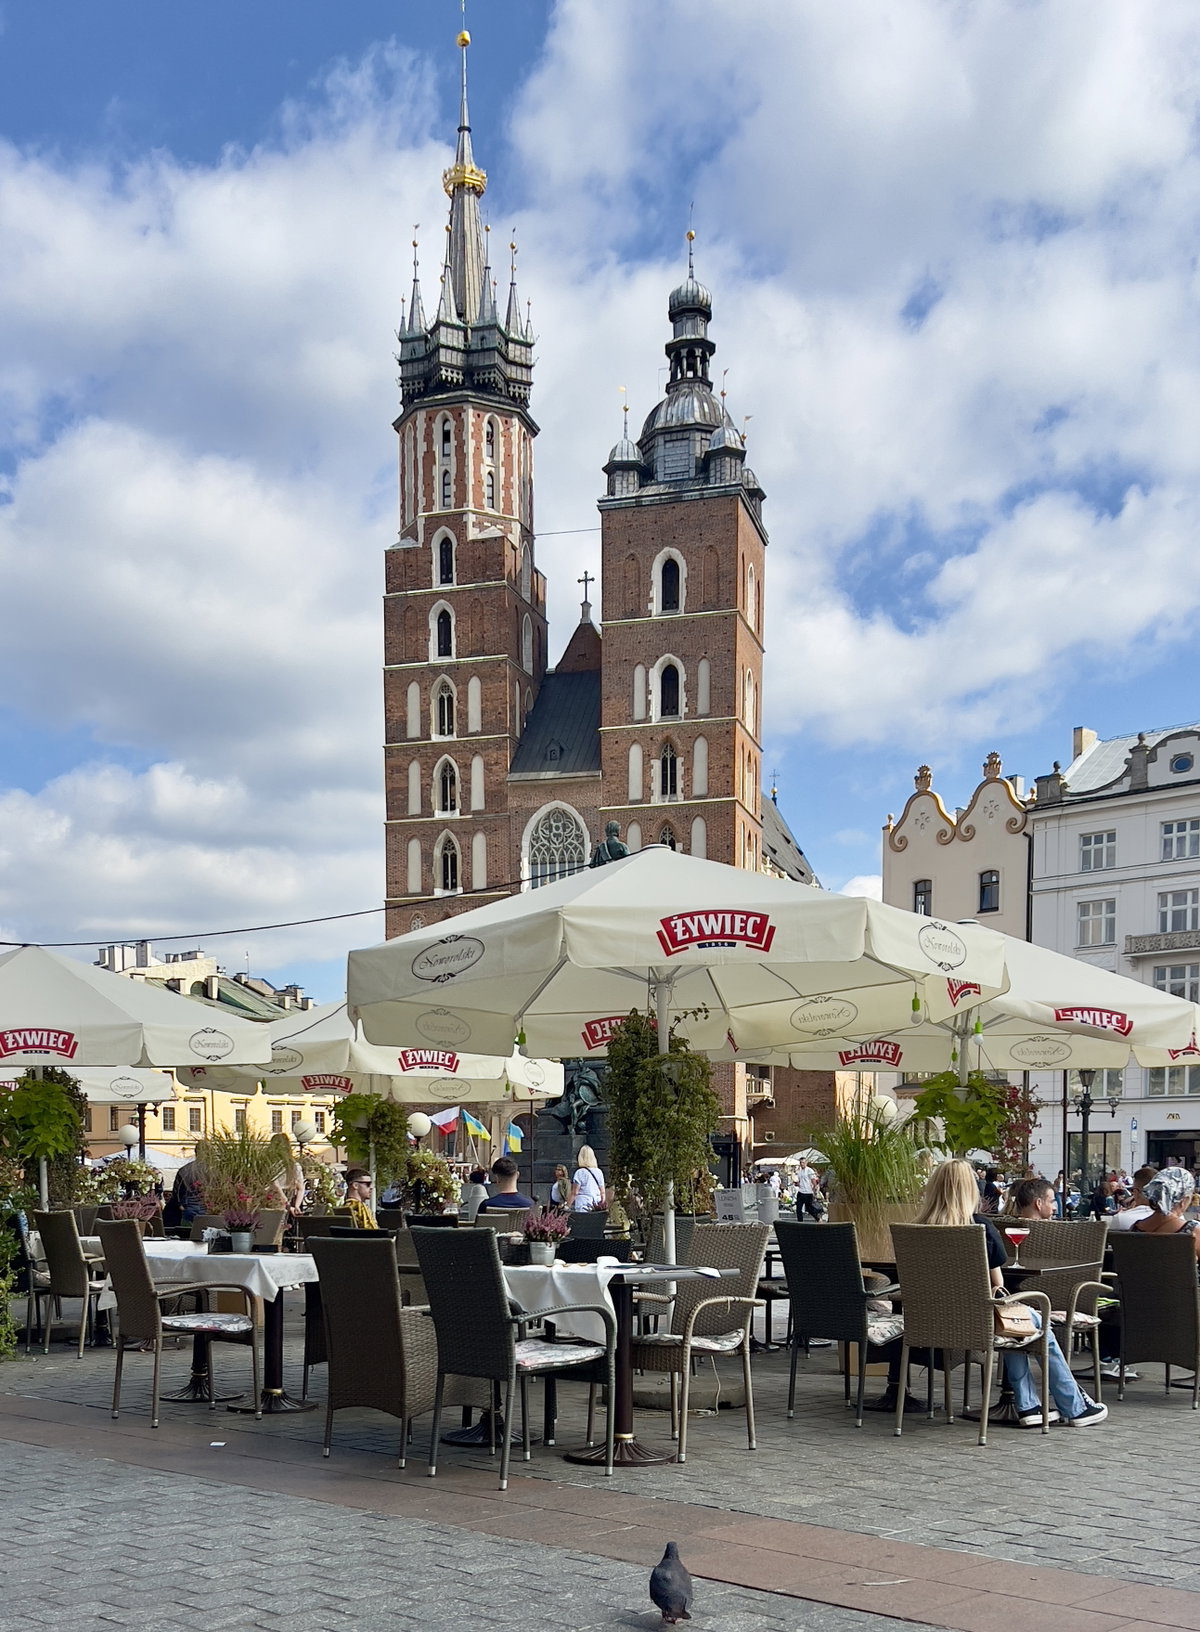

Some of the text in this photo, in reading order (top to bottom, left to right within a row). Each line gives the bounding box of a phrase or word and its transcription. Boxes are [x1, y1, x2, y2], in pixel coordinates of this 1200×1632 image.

[670, 913, 761, 942] ŻYWIEC
[3, 1031, 69, 1049] ŻYWIEC
[405, 1049, 453, 1065] ŻYWIEC
